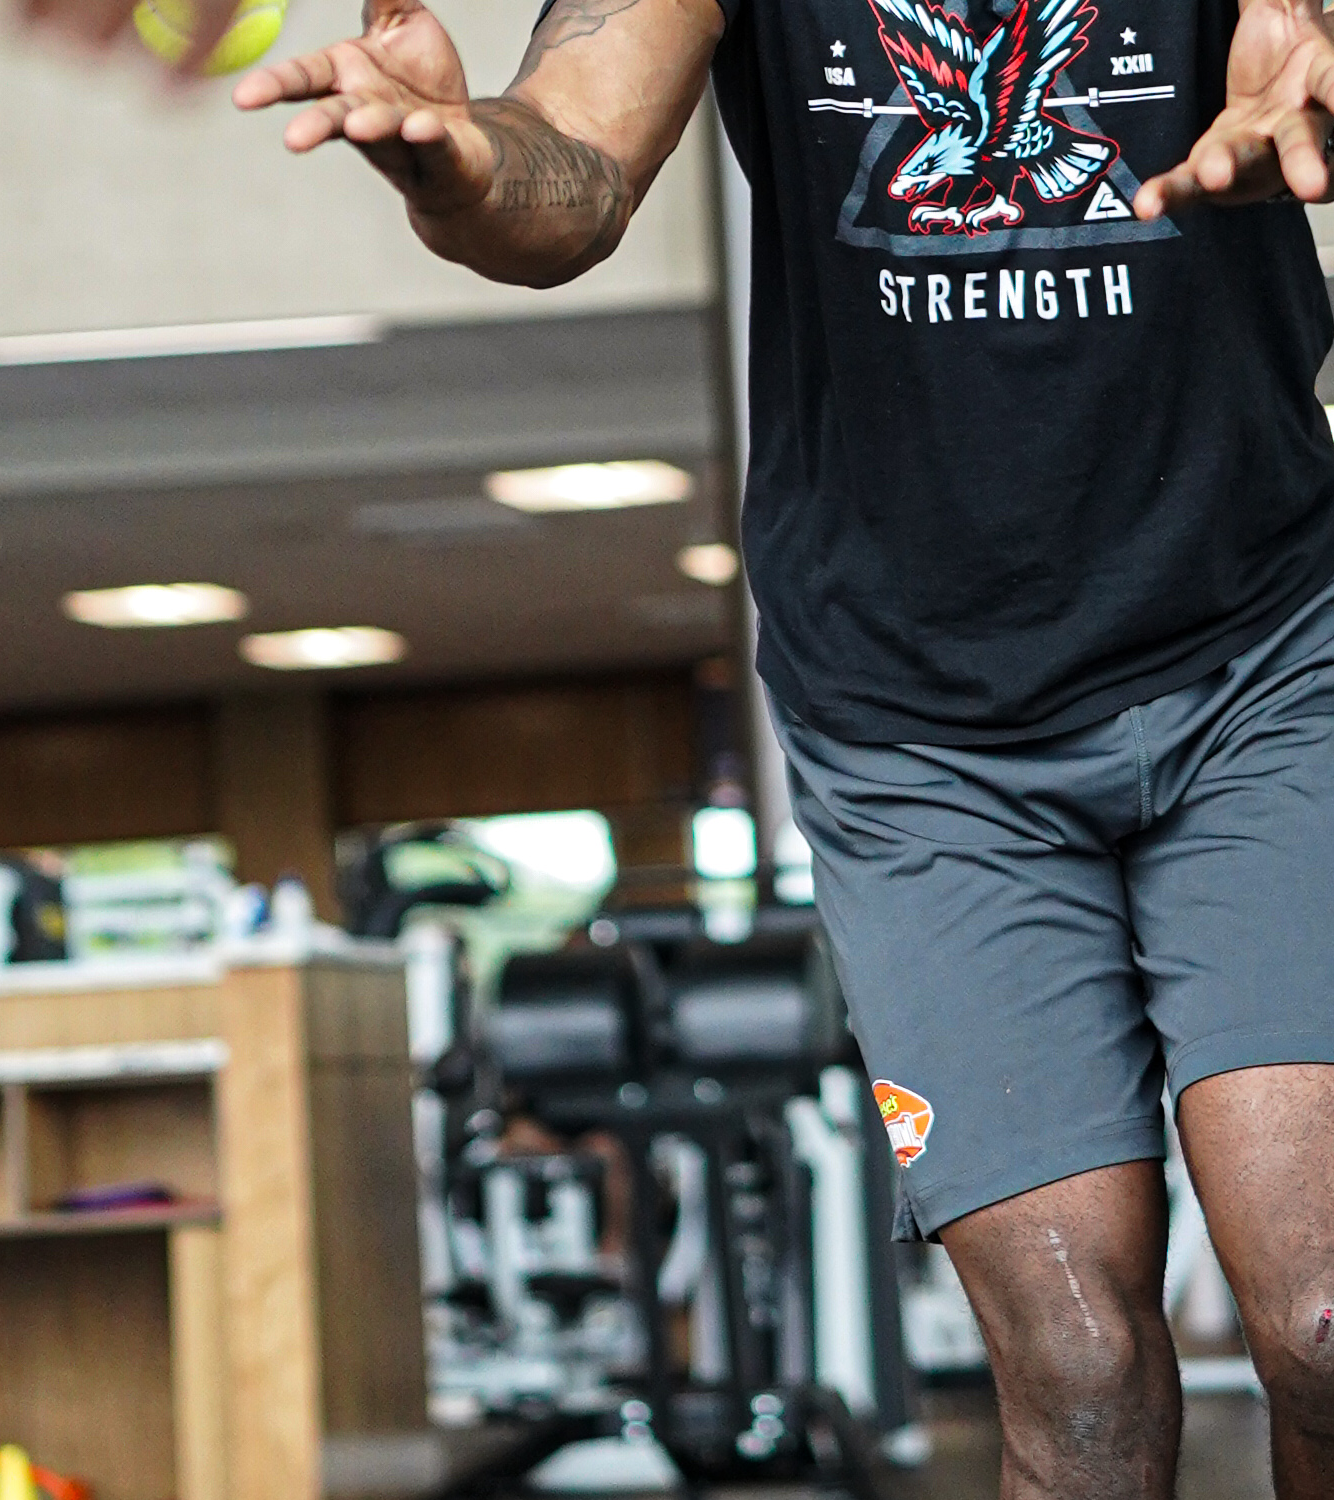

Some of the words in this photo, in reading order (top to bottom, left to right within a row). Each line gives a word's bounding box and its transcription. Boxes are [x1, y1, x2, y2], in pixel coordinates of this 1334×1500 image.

[1111, 53, 1153, 76] XXII
[823, 66, 856, 87] USA
[879, 264, 1133, 324] STRENGTH
